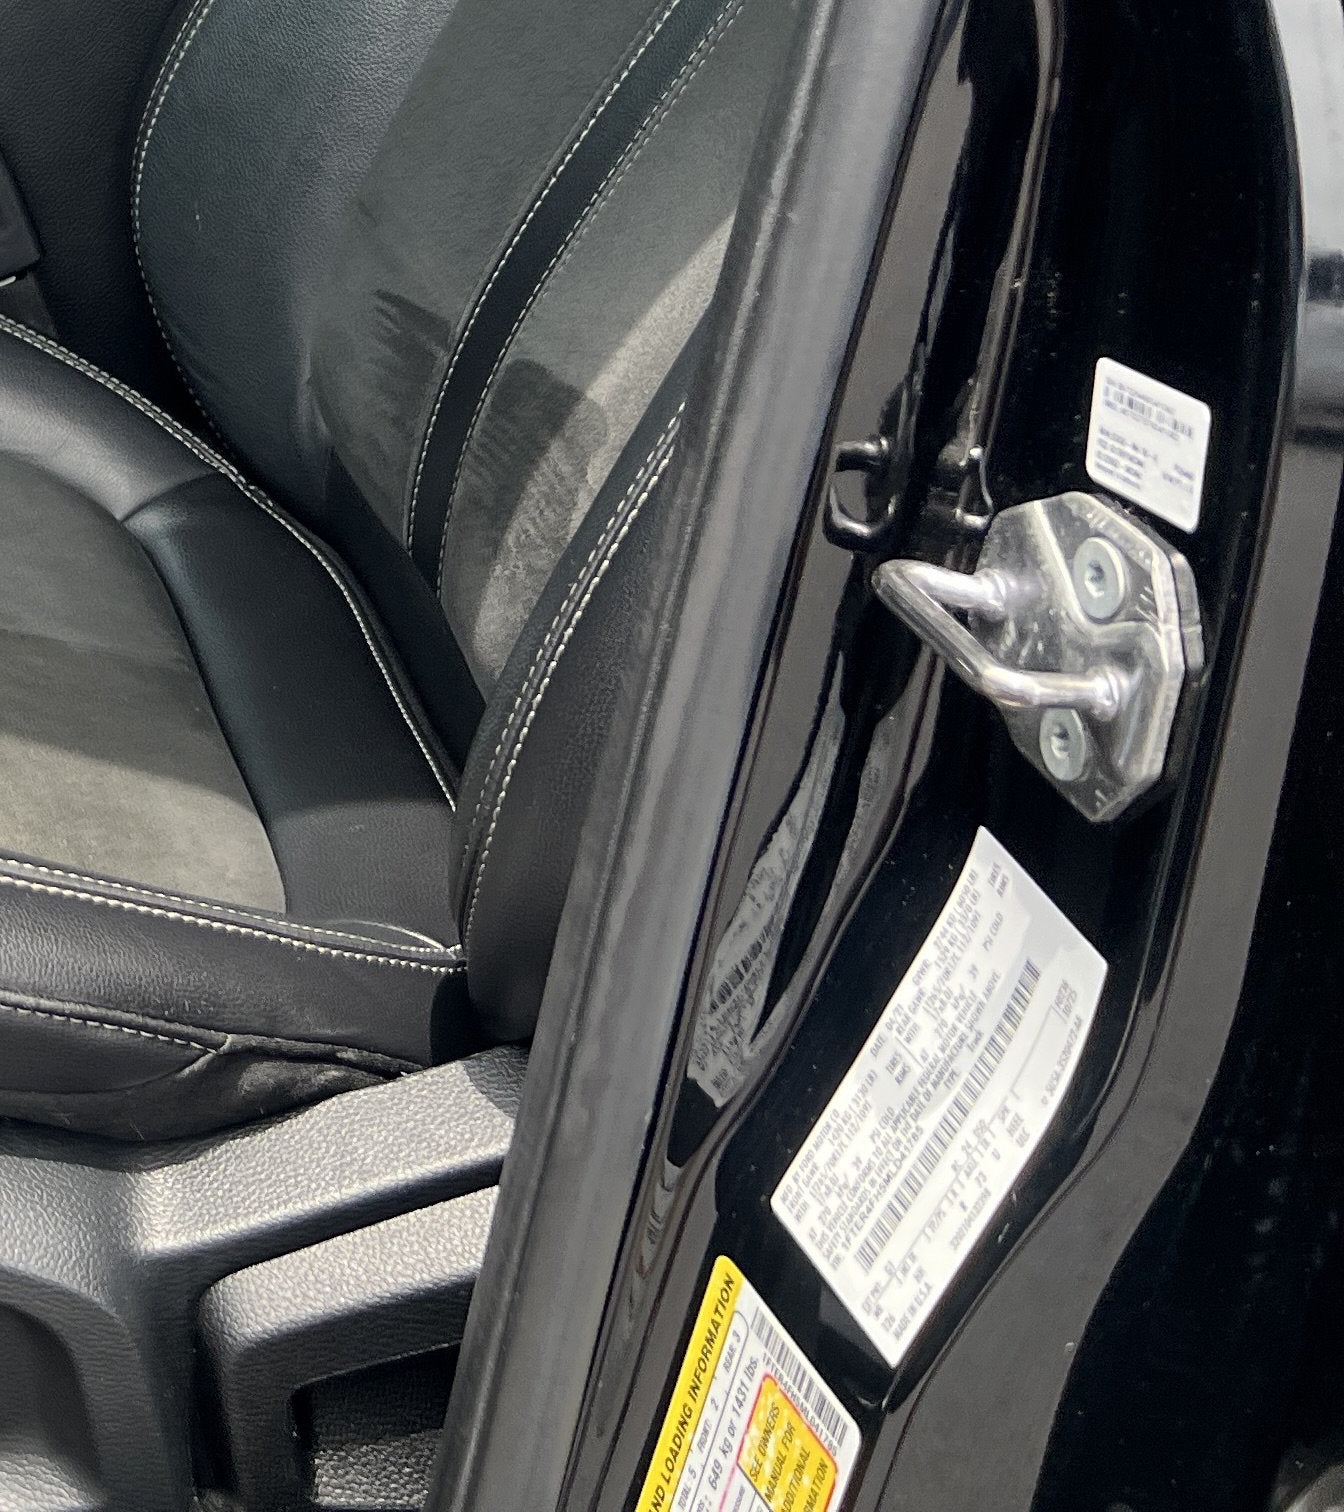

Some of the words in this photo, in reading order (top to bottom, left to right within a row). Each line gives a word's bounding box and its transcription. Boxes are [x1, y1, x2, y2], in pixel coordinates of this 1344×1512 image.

[929, 1027, 968, 1092] MANUFACTURE
[888, 1083, 920, 1136] APPLICABLE
[659, 1399, 693, 1486] LOADING
[686, 1271, 736, 1404] INFORMATION
[730, 1378, 749, 1419] 1431
[718, 1433, 733, 1461] kg
[726, 1417, 738, 1439] or
[748, 1452, 763, 1483] SEE
[756, 1399, 781, 1458] OWNERS
[707, 1456, 723, 1492] 649
[762, 1446, 787, 1503] MANUAL
[780, 1419, 796, 1451] FOR
